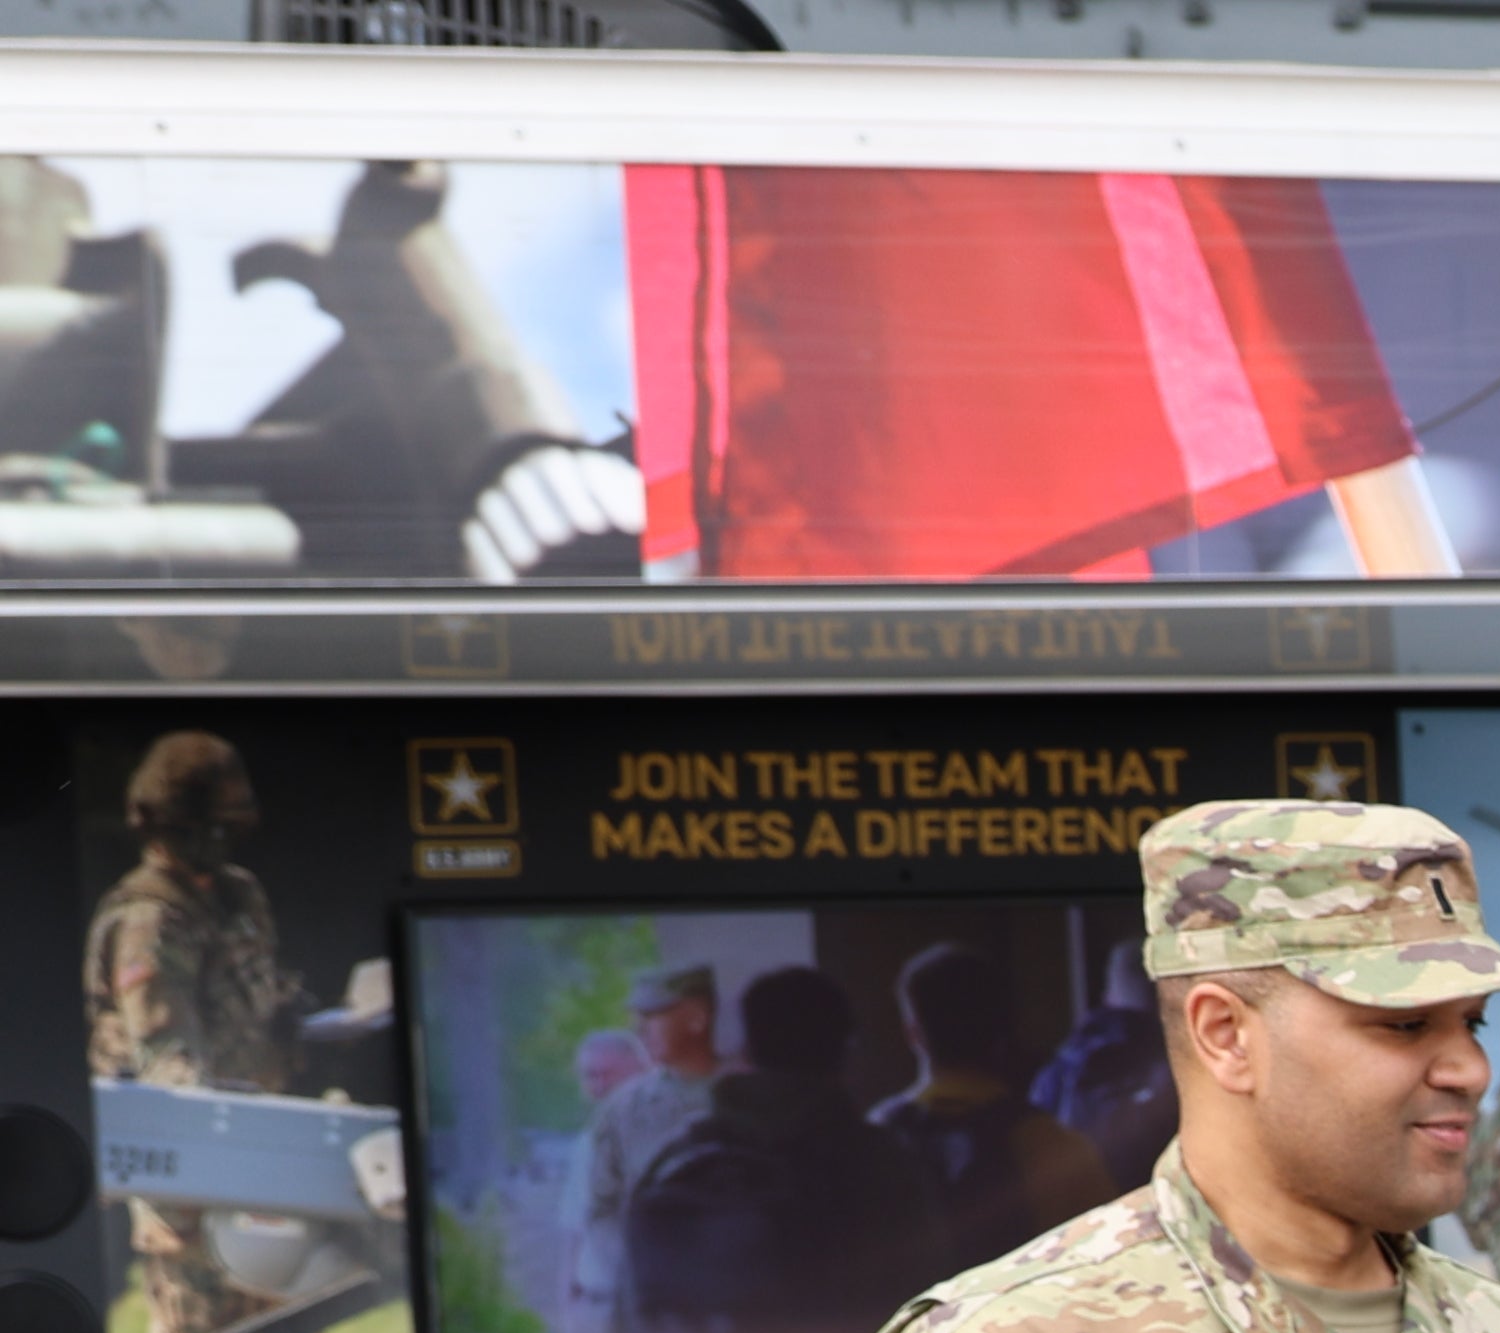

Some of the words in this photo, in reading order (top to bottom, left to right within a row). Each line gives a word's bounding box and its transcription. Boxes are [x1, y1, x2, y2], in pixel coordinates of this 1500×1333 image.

[611, 750, 738, 801] JOIN
[746, 750, 858, 800] THE
[867, 749, 1028, 799] TEAM
[1036, 748, 1187, 797] THAT
[592, 810, 795, 860] MAKES
[804, 810, 849, 858] A
